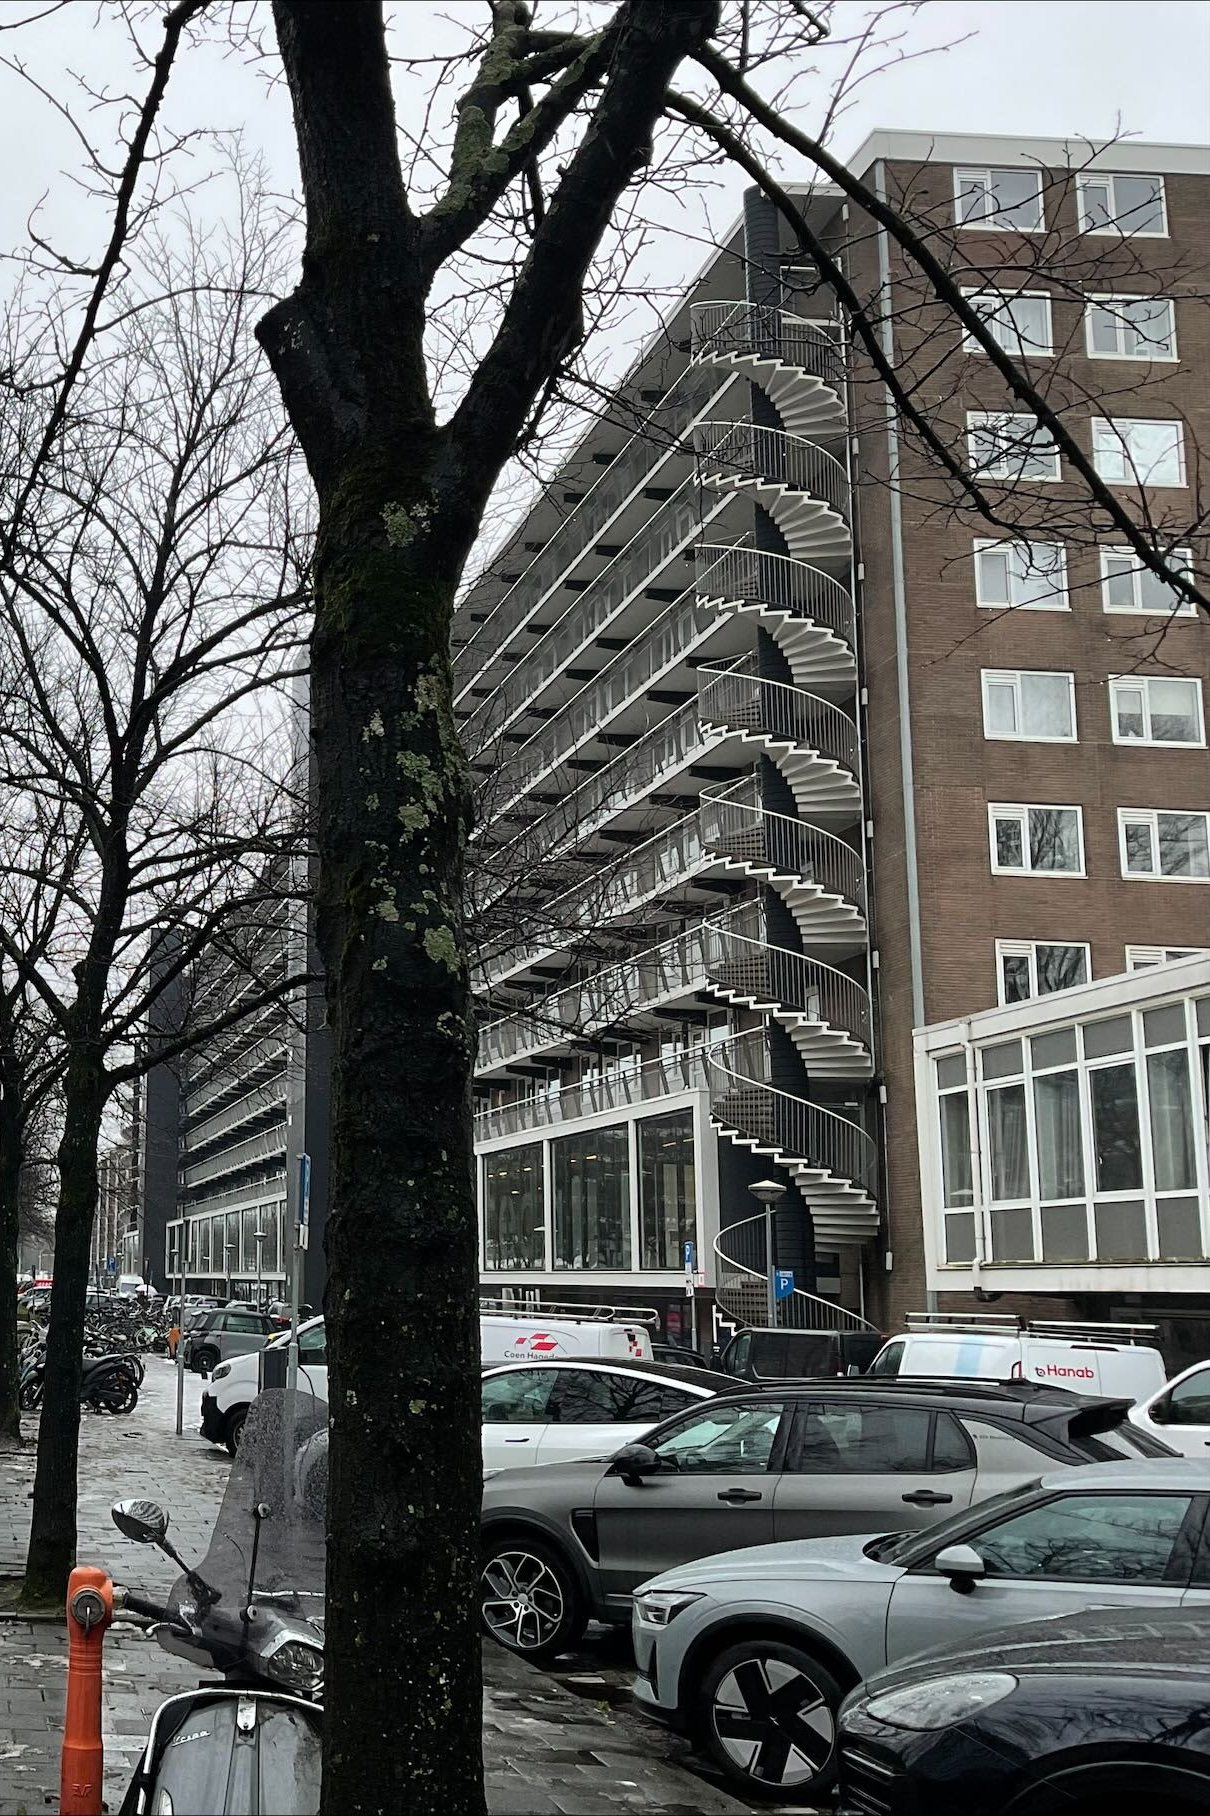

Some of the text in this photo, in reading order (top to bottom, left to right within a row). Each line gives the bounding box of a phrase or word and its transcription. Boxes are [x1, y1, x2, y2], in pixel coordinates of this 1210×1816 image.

[780, 1278, 788, 1290] P
[504, 1350, 525, 1358] Coen
[1047, 1365, 1094, 1378] Hanab
